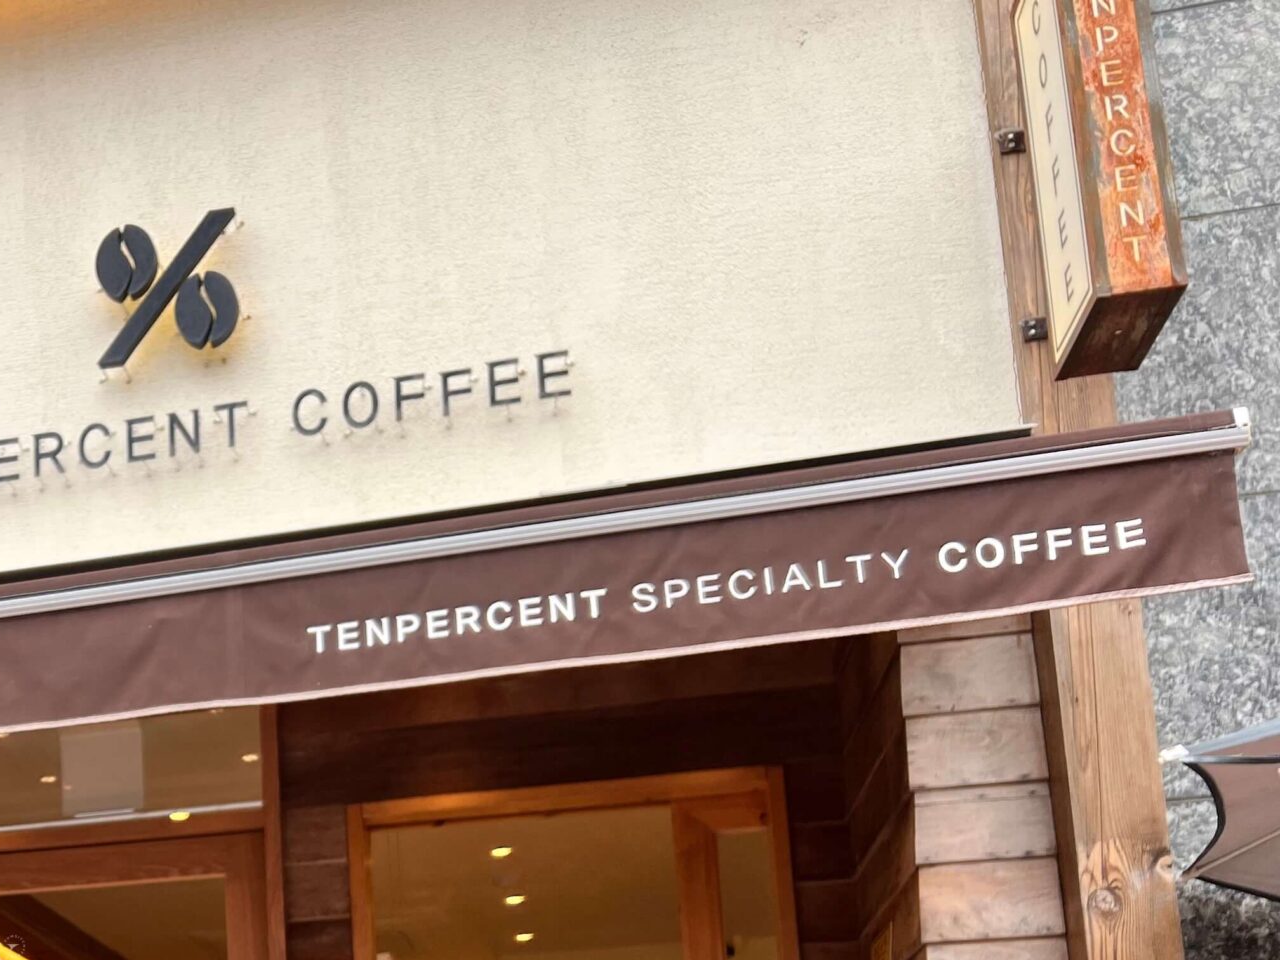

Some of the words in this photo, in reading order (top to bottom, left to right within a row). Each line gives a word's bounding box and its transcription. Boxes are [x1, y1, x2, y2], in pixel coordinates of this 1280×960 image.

[1031, 0, 1074, 303] COFFEE
[292, 349, 574, 437] COFFEE
[307, 587, 609, 654] TENPERCENT
[631, 548, 910, 614] SPECIALTY
[937, 517, 1148, 574] COFFEE
